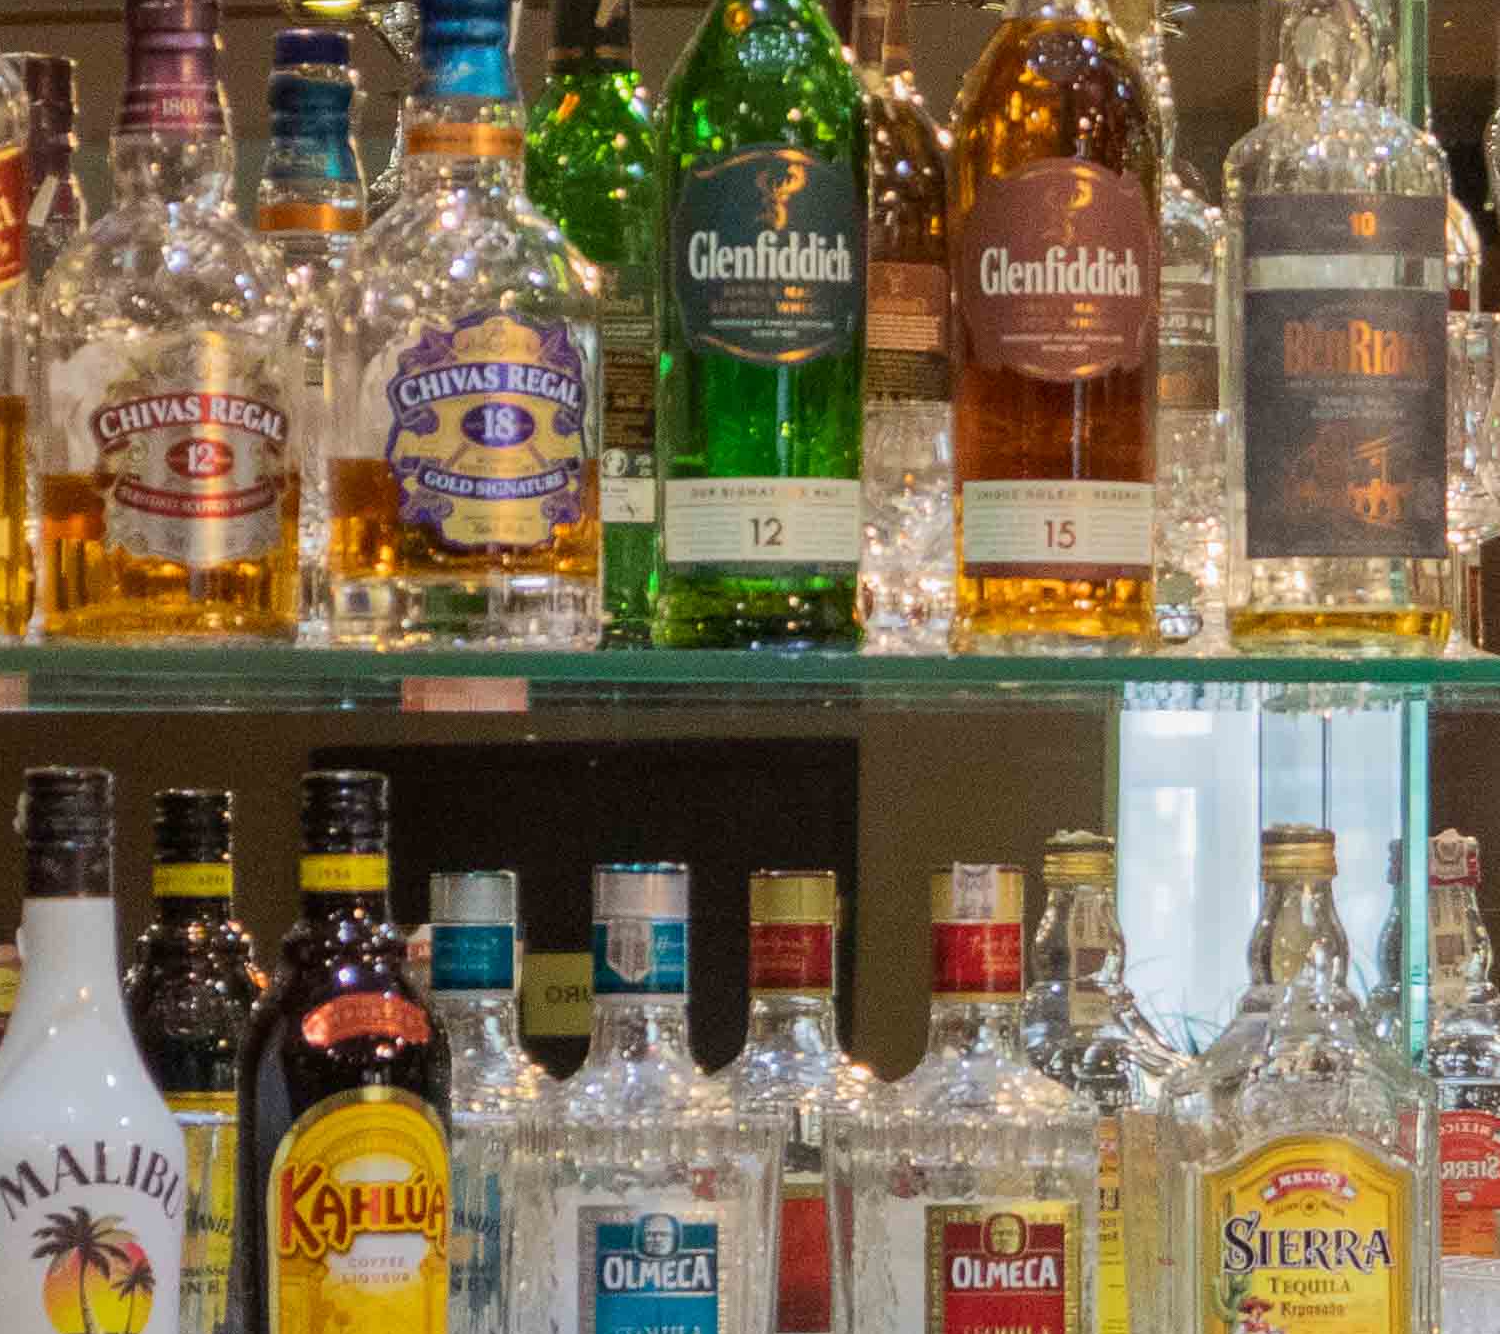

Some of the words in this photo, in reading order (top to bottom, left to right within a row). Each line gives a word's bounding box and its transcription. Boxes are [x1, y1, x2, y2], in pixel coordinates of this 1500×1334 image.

[687, 229, 853, 284] Glenfiddich
[979, 244, 1141, 298] Glenfiddich
[400, 367, 499, 407] CHIVAS
[507, 367, 581, 408] REGAL
[98, 395, 203, 440] CHIVAS
[206, 395, 285, 443] REGAL
[483, 409, 514, 437] 18
[187, 443, 214, 471] 12
[422, 470, 473, 496] GOLD
[474, 469, 565, 497] SIGNATURE
[748, 518, 784, 547] 12
[1043, 520, 1077, 549] 15
[1278, 1170, 1342, 1188] MEXICO
[1223, 1210, 1396, 1275] SIERRA
[602, 1255, 713, 1291] OLMECA
[951, 1255, 1059, 1289] OLMECA
[1268, 1277, 1353, 1297] TEQUILA
